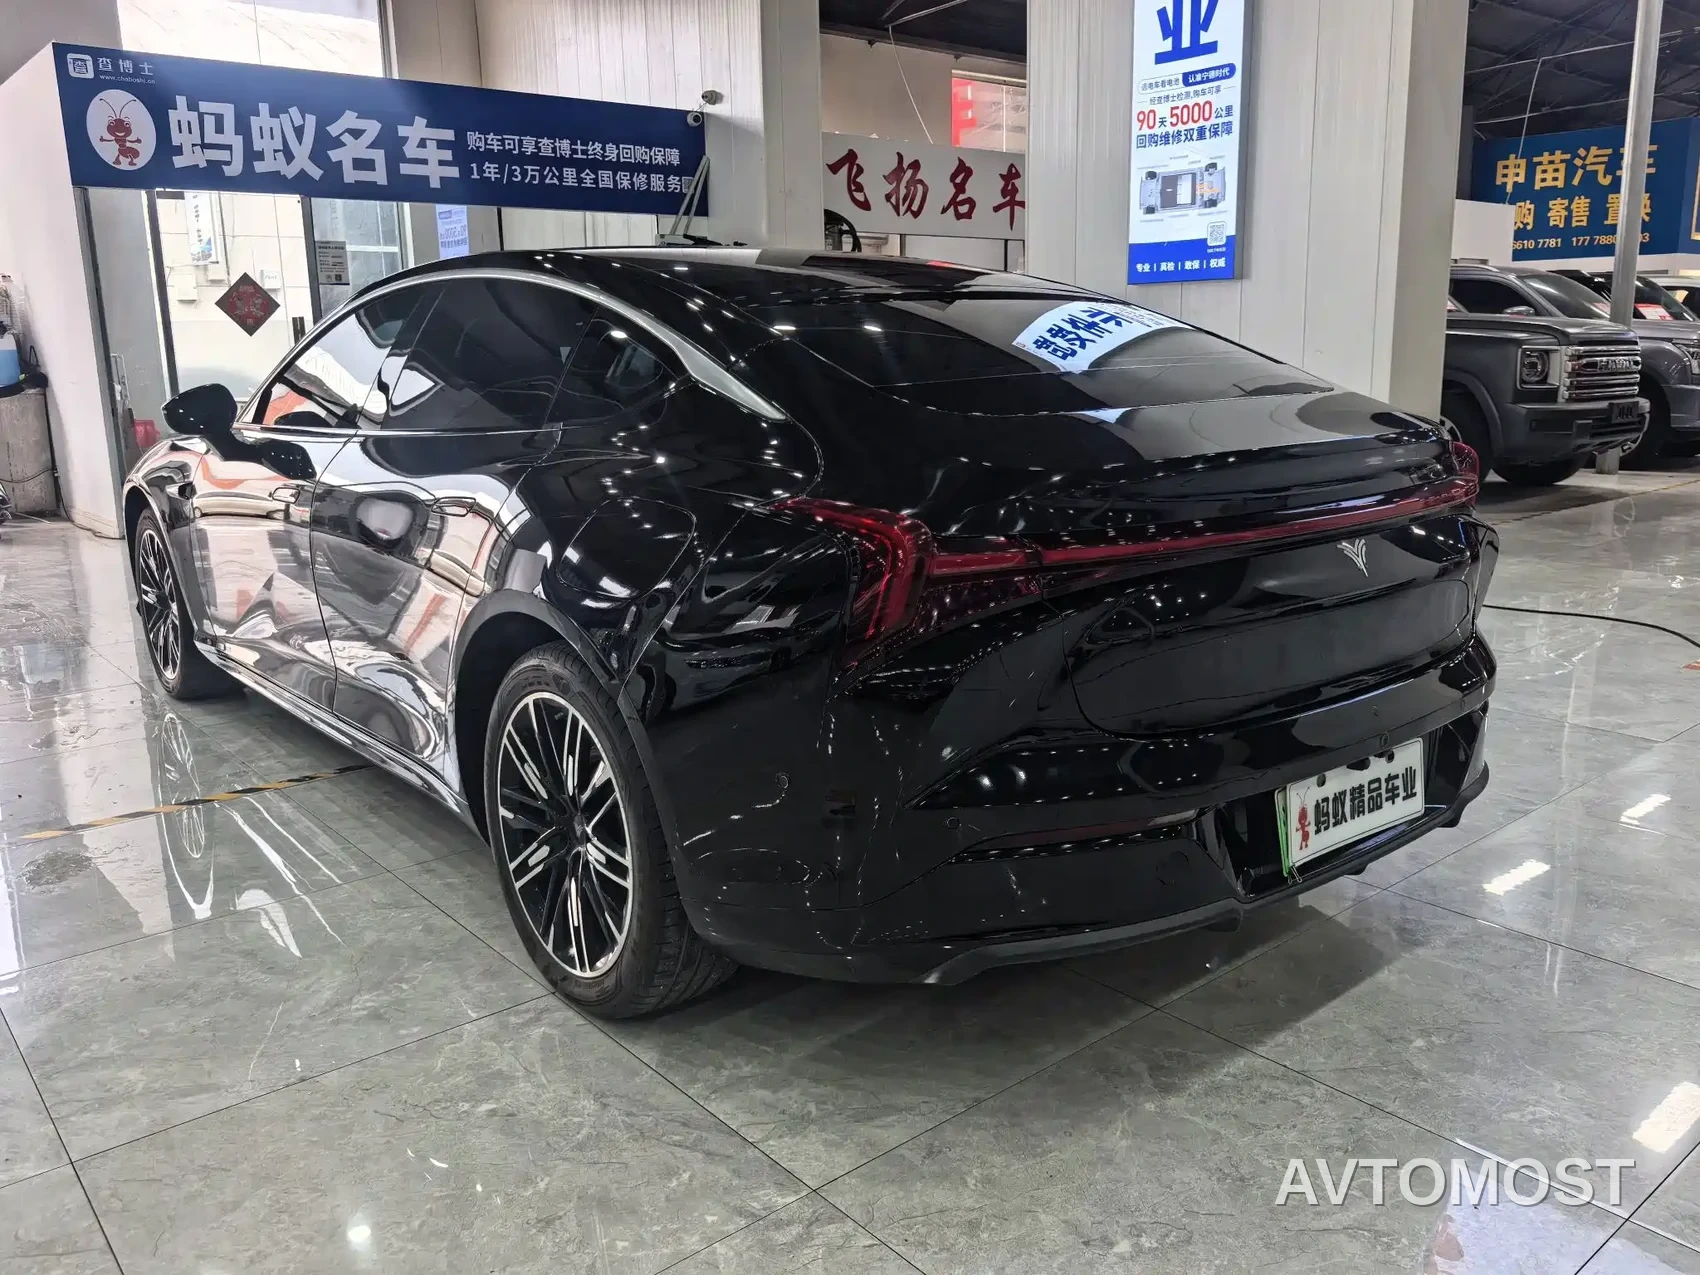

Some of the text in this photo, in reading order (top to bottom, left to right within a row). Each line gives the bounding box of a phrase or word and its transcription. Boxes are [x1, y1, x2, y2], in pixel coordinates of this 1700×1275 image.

[97, 57, 154, 76] 查博士
[99, 74, 156, 84] www.chaboshi.cn
[168, 95, 459, 188] 蚂蚁名车
[467, 131, 681, 166] 购车可享查博士终身回购保障
[1136, 120, 1234, 149] 回购维修双重保障
[470, 161, 681, 193] 1年/3万公里全国保修服务
[826, 148, 1025, 231] 飞扬名车
[1547, 195, 1591, 229] 寄售
[1537, 237, 1562, 249] 7781
[1571, 236, 1591, 247] 177
[1314, 766, 1417, 835] 蚂蚁精品车业
